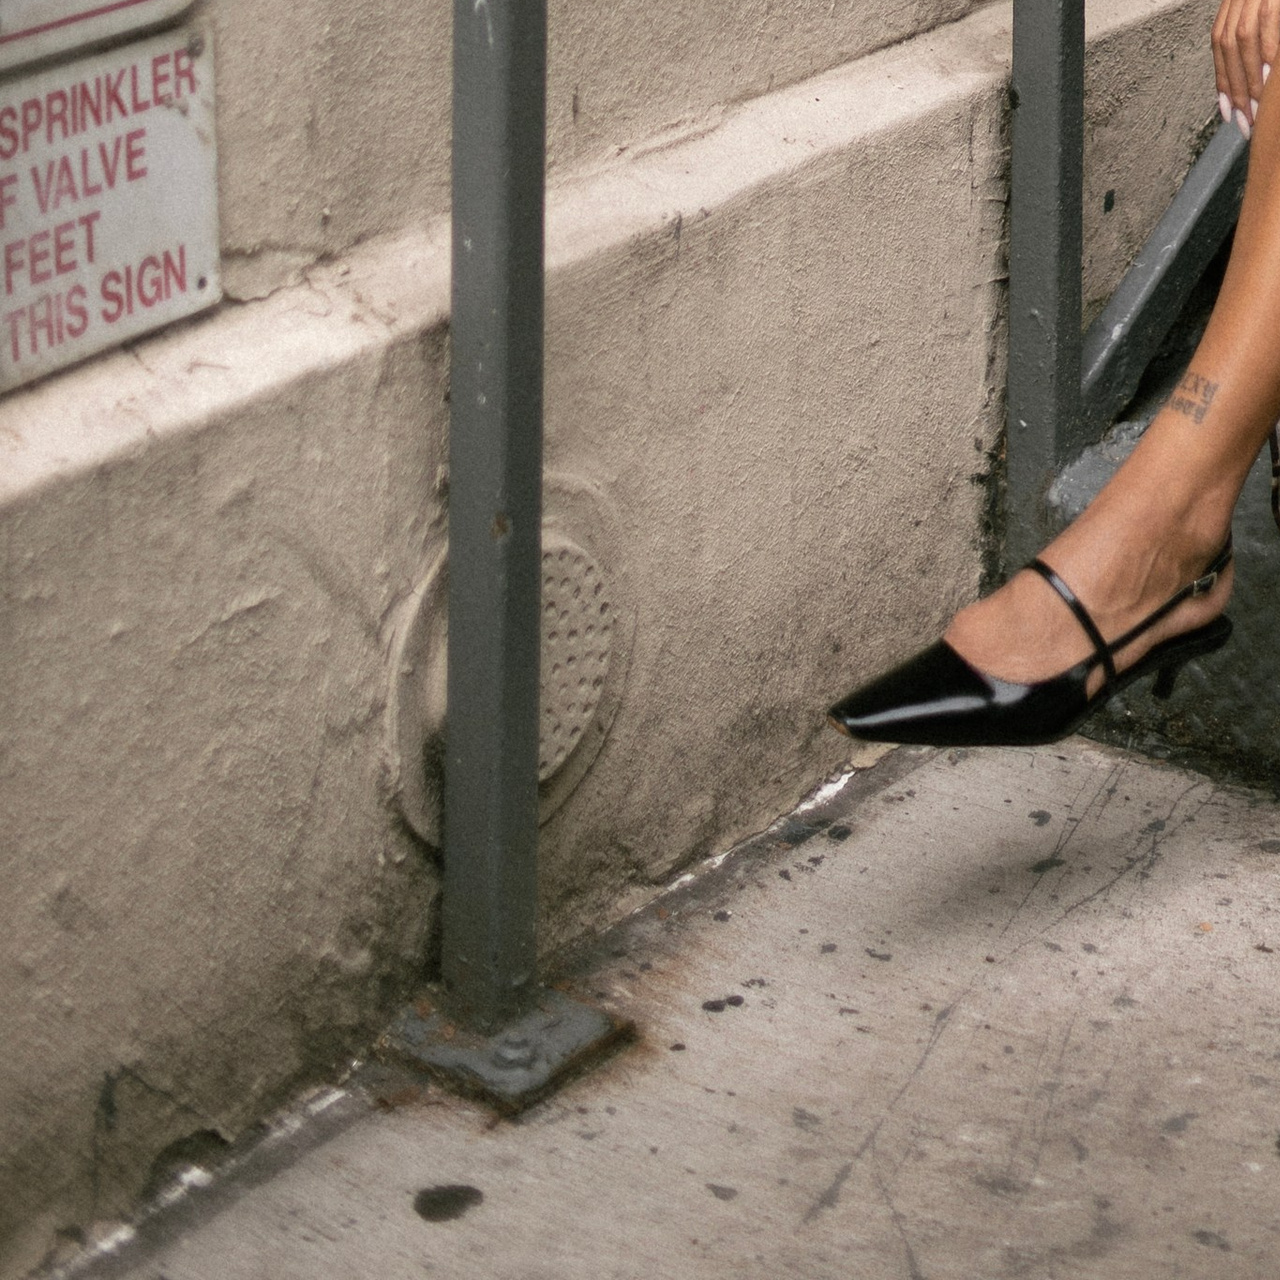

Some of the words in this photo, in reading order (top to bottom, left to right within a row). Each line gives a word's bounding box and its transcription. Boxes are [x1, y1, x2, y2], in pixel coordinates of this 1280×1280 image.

[0, 48, 197, 161] SPRINKLER
[31, 128, 147, 214] VALVE
[5, 211, 101, 296] FEET
[4, 284, 90, 362] THIS
[101, 245, 188, 324] SIGN
